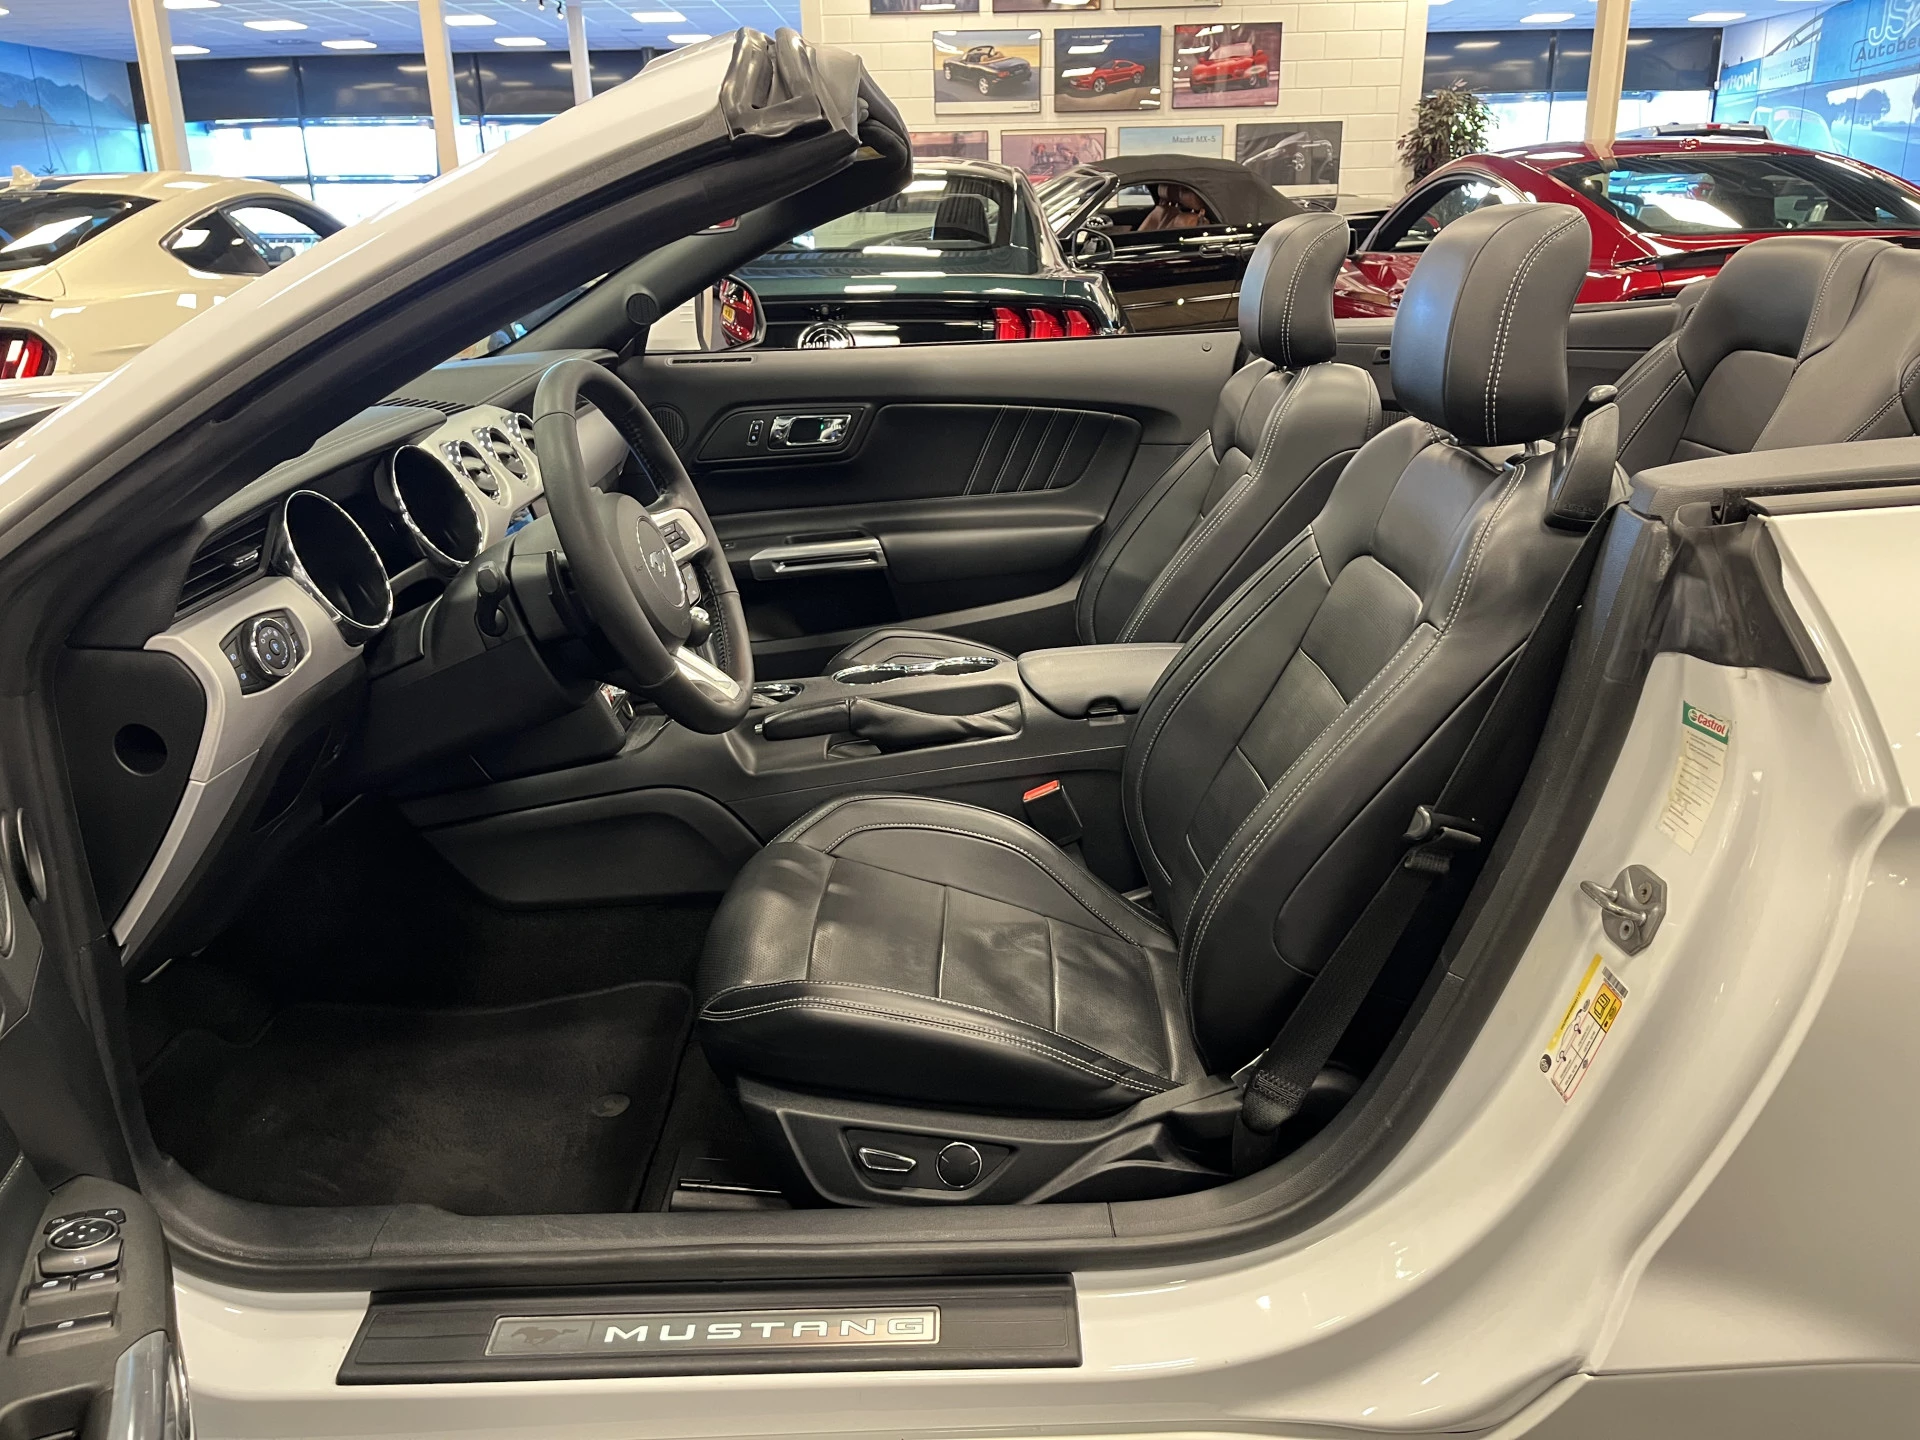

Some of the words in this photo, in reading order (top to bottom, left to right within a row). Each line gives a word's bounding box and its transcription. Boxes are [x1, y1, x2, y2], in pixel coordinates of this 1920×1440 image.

[1855, 36, 1920, 64] Autobe
[1196, 135, 1216, 143] MX-5
[1697, 713, 1726, 735] Castrol
[604, 1318, 925, 1343] MUSTANG
